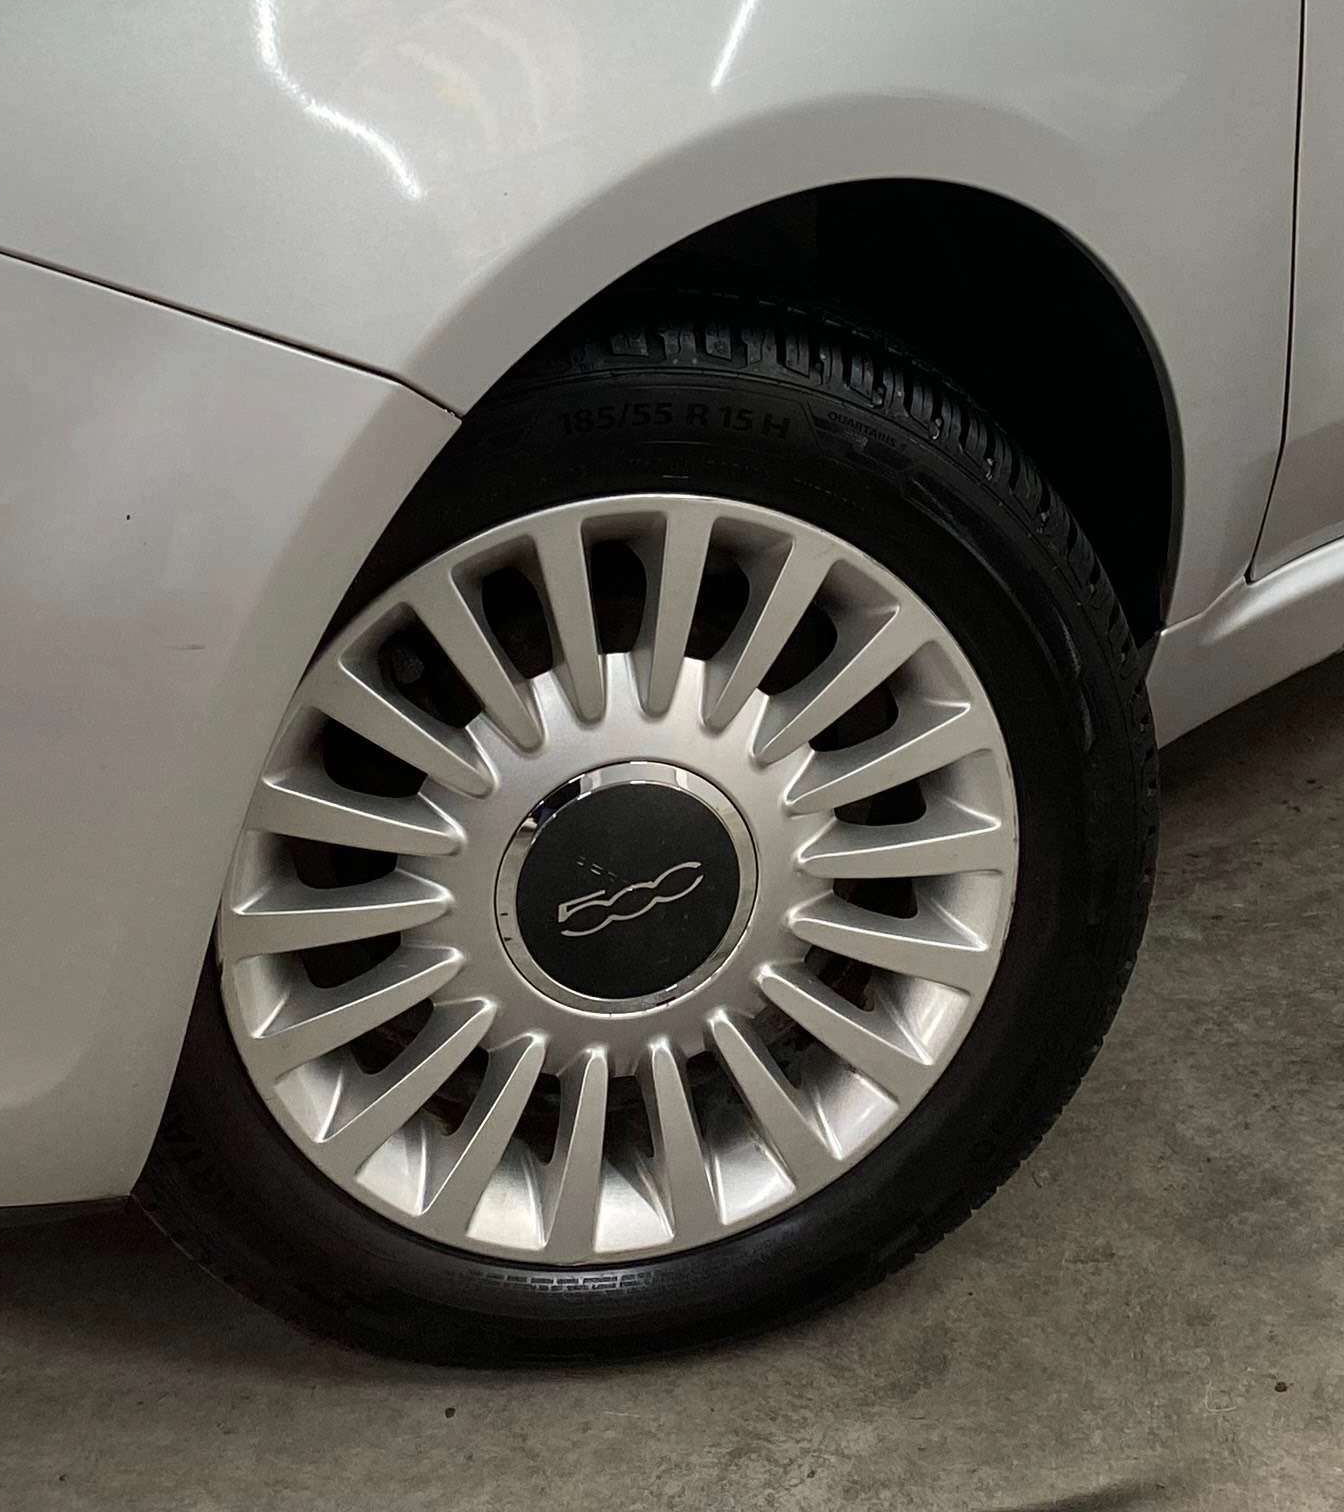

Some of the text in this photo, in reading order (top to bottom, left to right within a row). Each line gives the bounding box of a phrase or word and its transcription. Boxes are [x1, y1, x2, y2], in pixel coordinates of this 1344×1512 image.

[558, 402, 673, 435] 185/55
[720, 405, 753, 432] 15
[557, 861, 705, 937] 500
